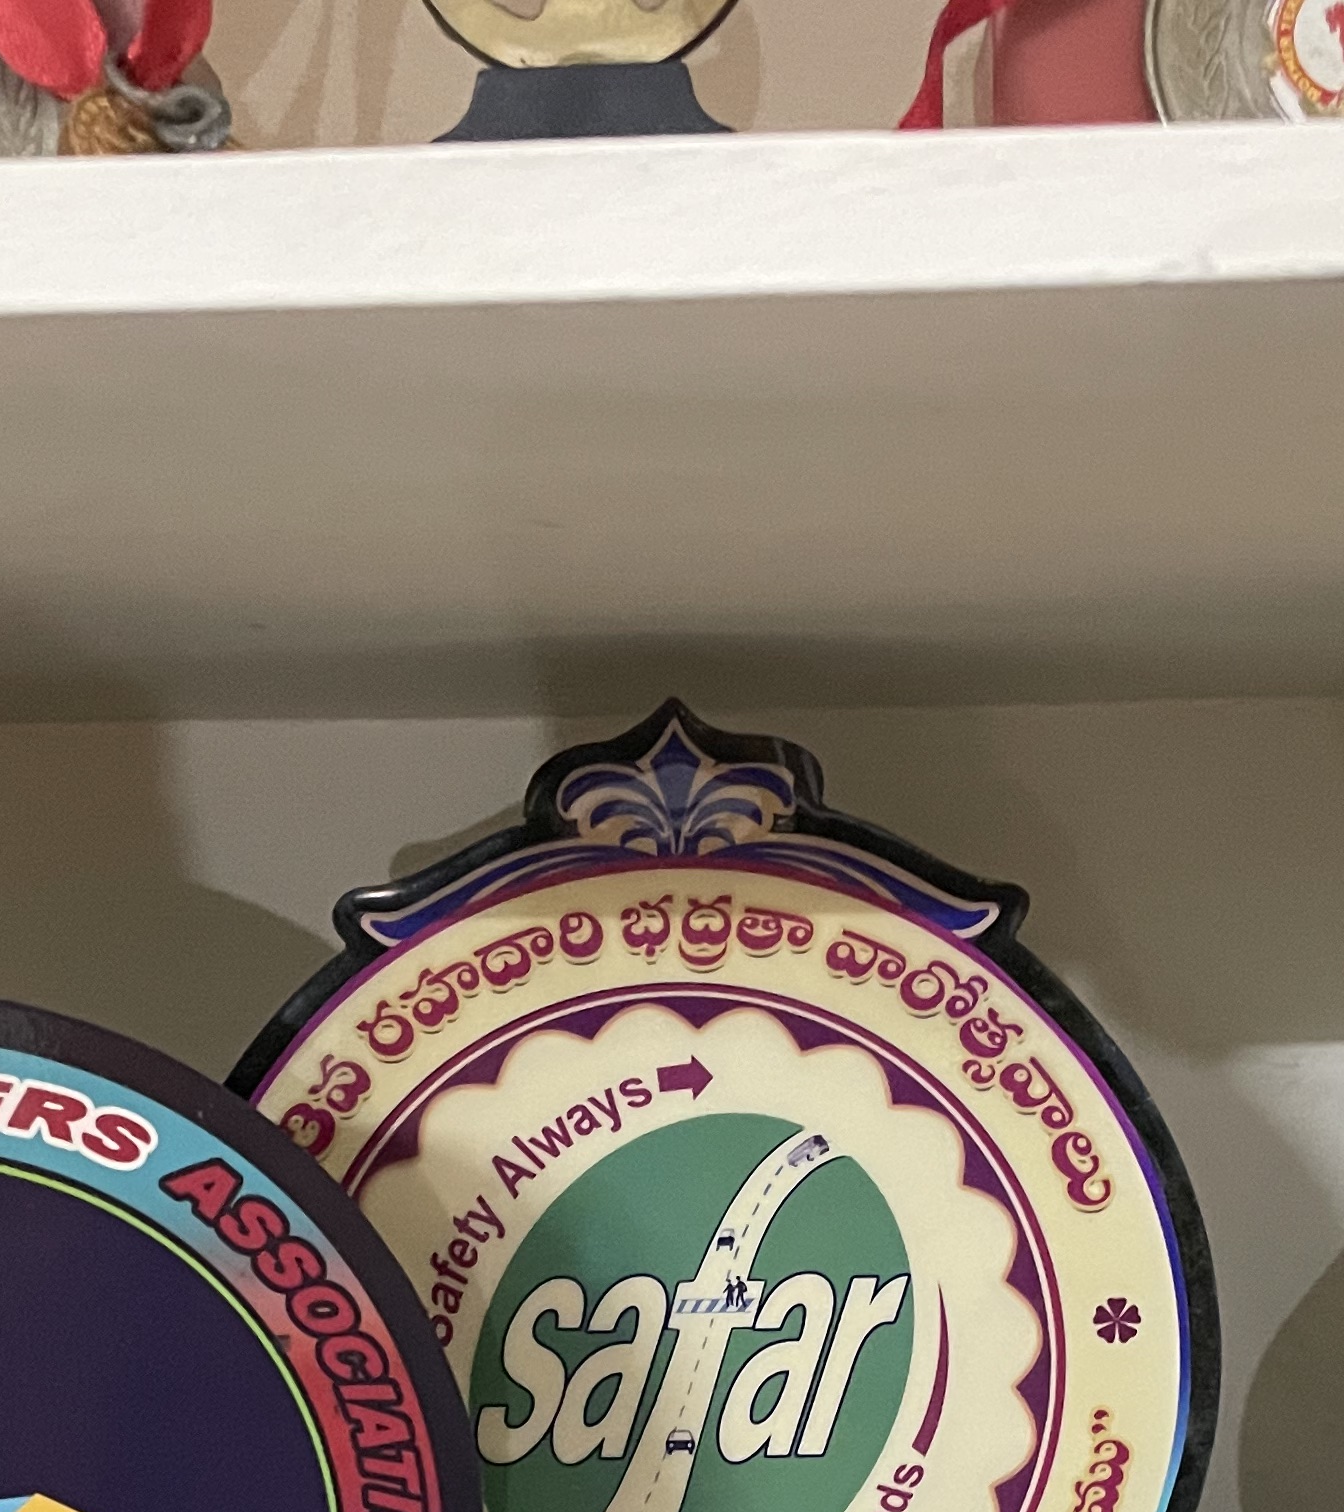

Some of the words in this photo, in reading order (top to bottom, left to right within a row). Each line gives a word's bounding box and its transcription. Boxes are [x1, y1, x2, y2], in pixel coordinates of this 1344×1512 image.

[356, 911, 604, 1058] రహదారి
[620, 894, 814, 968] భద్రతా
[825, 928, 1112, 1209] వారోత్సవాలు
[492, 1078, 653, 1199] Always
